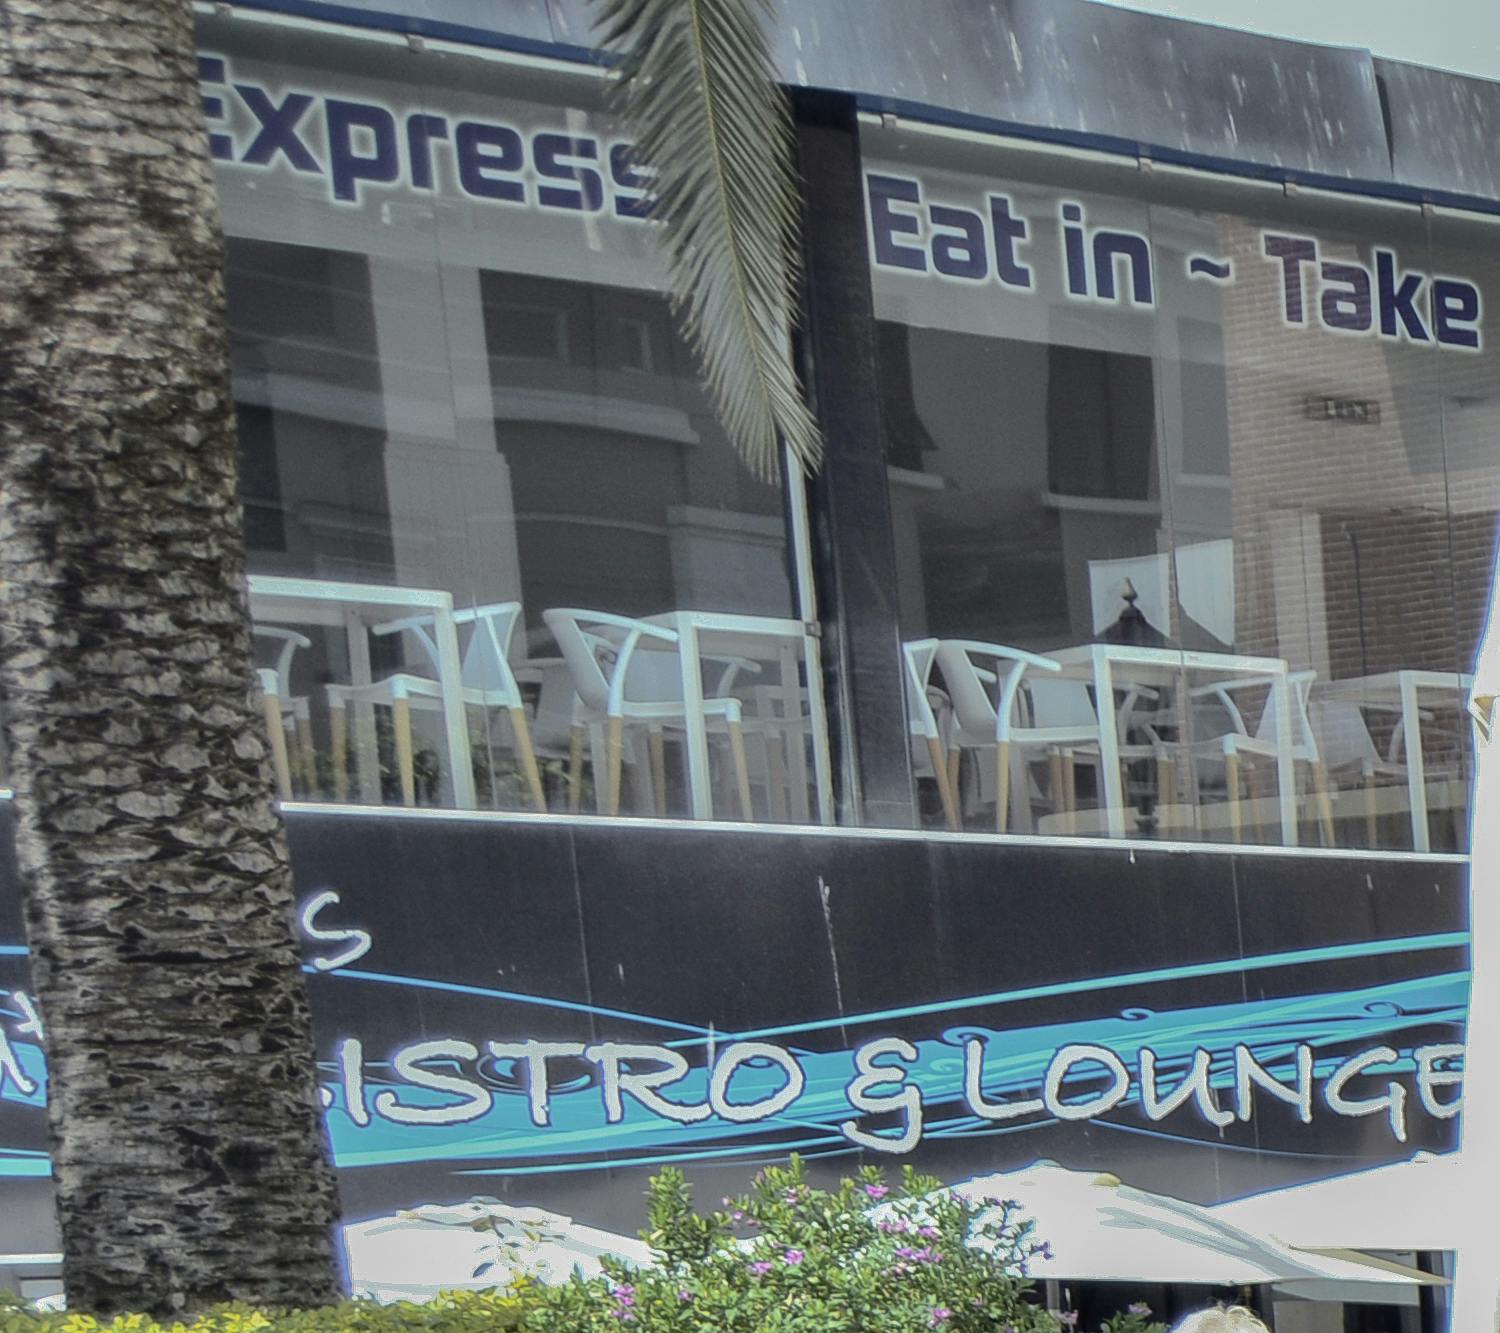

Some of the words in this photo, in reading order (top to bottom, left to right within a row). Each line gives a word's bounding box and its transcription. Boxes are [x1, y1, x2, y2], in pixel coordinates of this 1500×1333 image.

[865, 173, 1032, 289] Eat
[1061, 203, 1153, 305] in
[1262, 233, 1480, 349] Take
[322, 1037, 804, 1126] ISTRO
[840, 1037, 923, 1153] &
[963, 1038, 1464, 1142] LOUNGE
